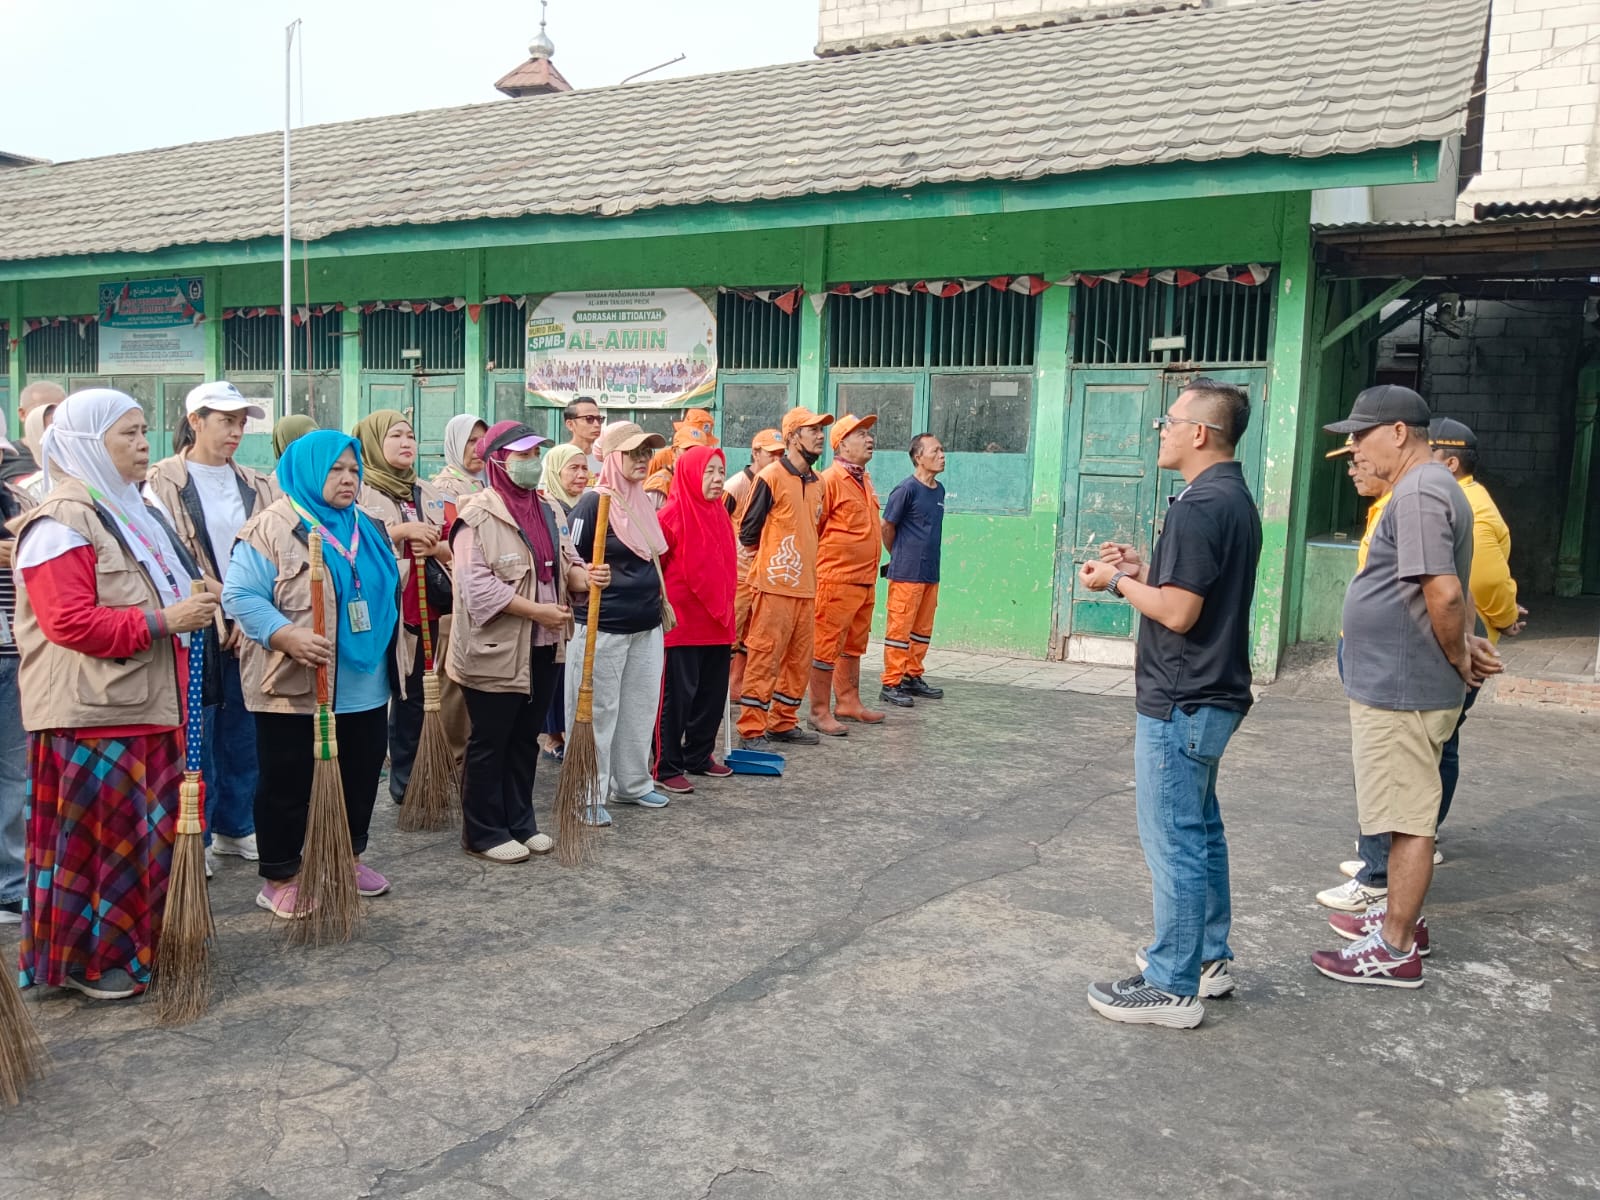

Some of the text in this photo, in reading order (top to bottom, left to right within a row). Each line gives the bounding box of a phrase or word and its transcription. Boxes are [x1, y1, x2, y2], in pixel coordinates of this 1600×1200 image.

[576, 311, 662, 321] MADRASAH IBTIDAIYAH
[568, 328, 667, 350] AL-AMIN
